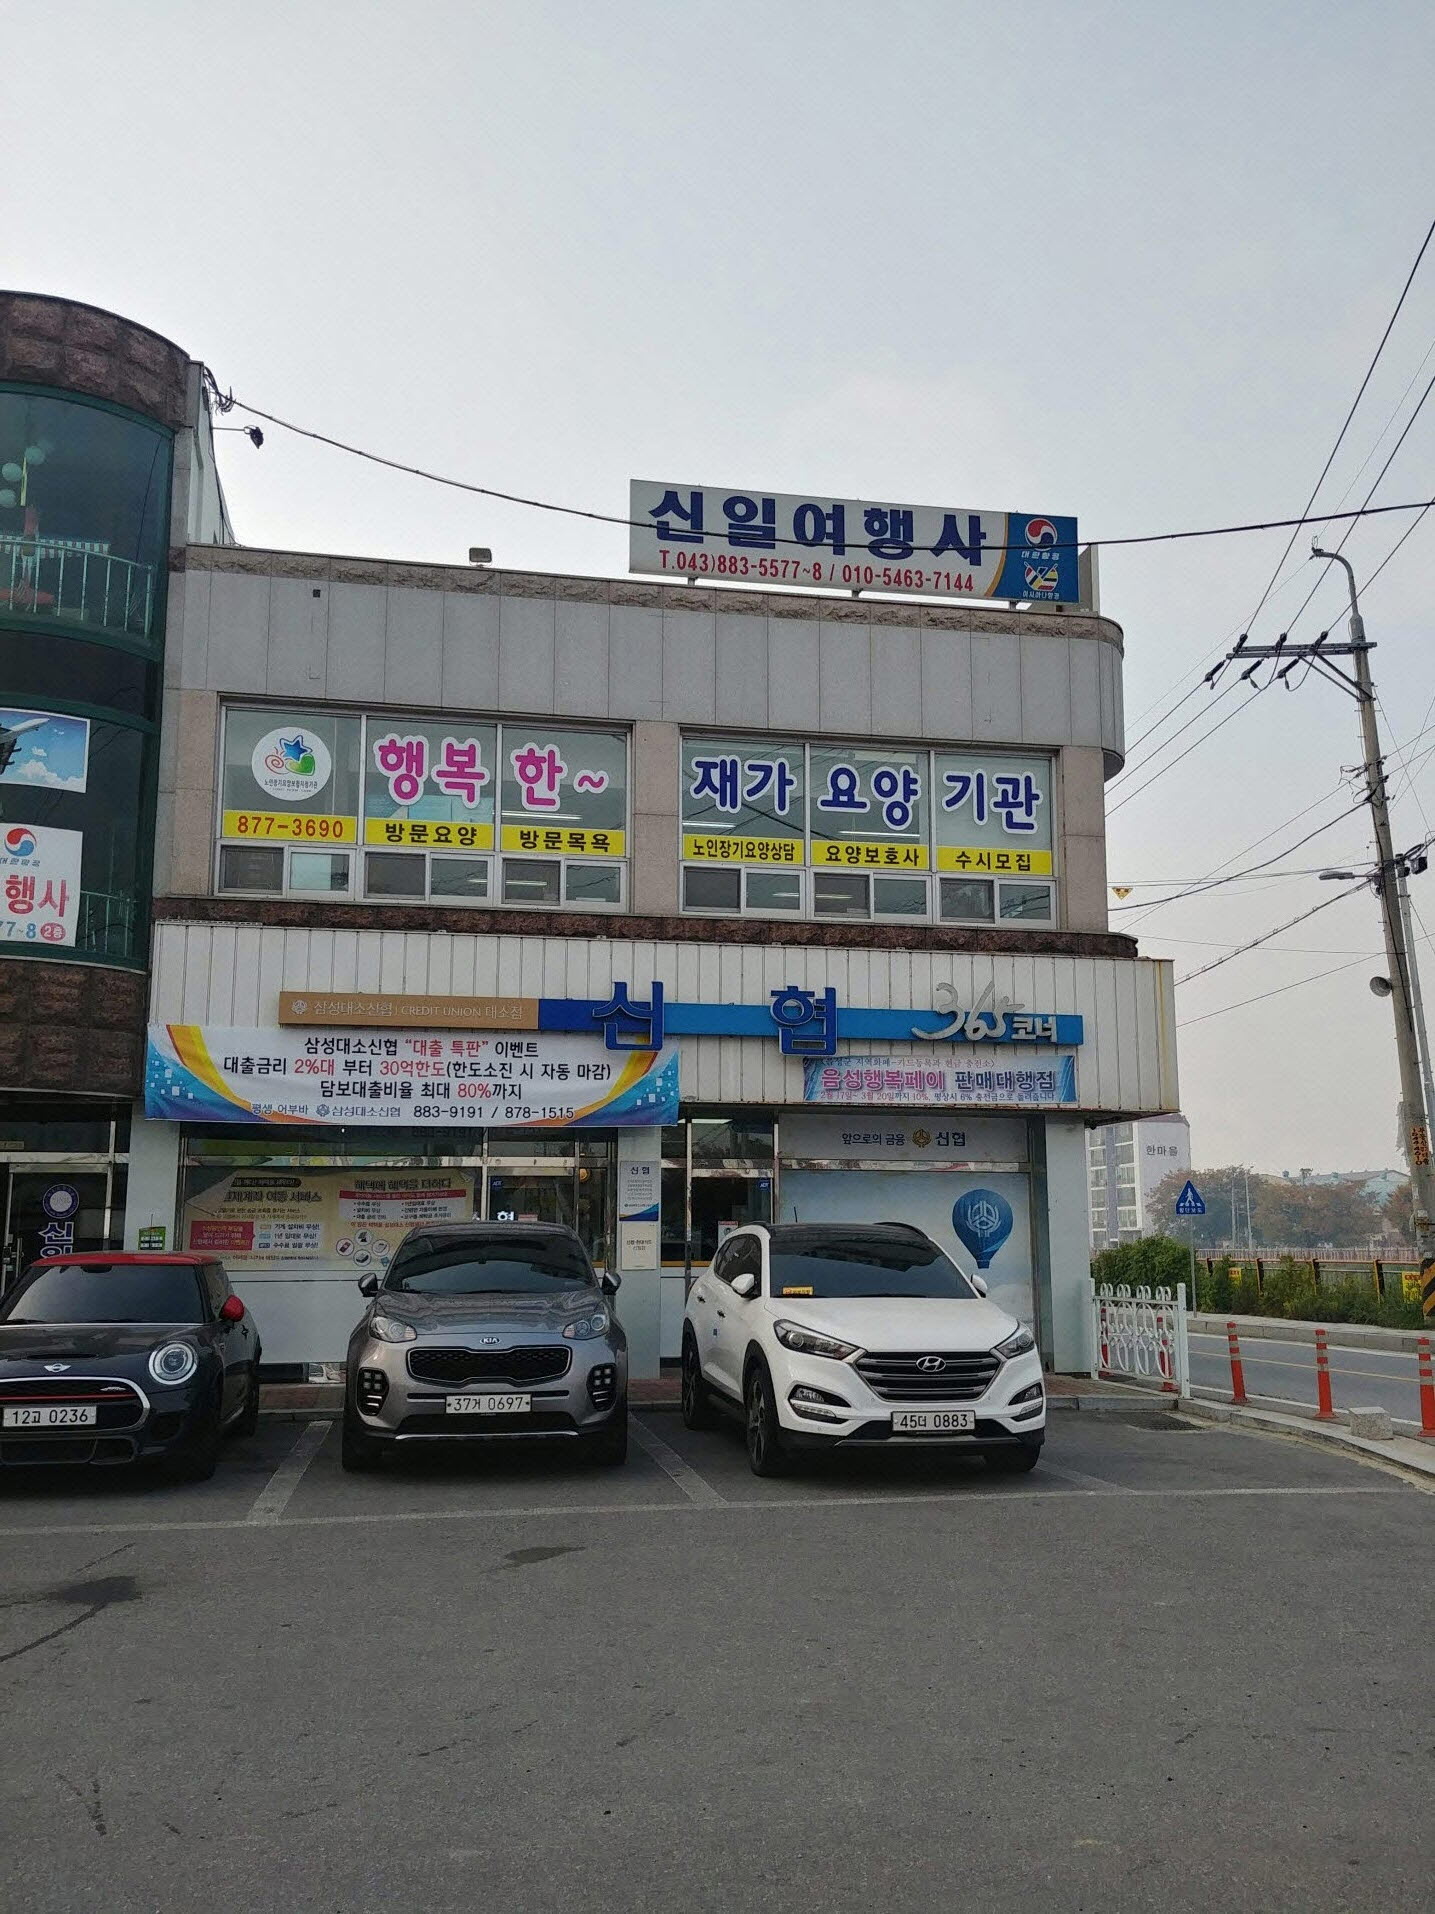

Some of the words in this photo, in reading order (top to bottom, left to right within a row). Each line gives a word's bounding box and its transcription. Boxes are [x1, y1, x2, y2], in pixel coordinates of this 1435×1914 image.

[648, 489, 986, 566] 신일여행사
[659, 550, 822, 581] T.043)883-5577~8
[842, 563, 974, 592] 010-5463-7144
[692, 757, 796, 813] 재가
[818, 765, 921, 829] 요양
[943, 769, 1042, 833] 기관
[237, 815, 344, 838] 877-3690
[385, 823, 478, 846] 방문요양
[519, 829, 611, 852] 방문목욕
[692, 840, 796, 861] 노인장기요양상담
[825, 844, 920, 866] 요양보호사
[955, 850, 1031, 872] 수시모집
[314, 1002, 393, 1017] 삼성대소신협
[401, 1006, 439, 1017] CREDIT
[442, 1006, 482, 1018] UNION
[304, 1037, 398, 1055] 삼성대소신협
[495, 1041, 539, 1058] 이벤트
[223, 1056, 287, 1075] 대출금리
[293, 1059, 335, 1076] 2%대
[342, 1060, 372, 1077] 부터
[519, 1062, 534, 1079] 시
[541, 1063, 571, 1081] 자동
[577, 1063, 612, 1080] 마감)
[320, 1080, 414, 1099] 담보대출비율
[421, 1082, 451, 1099] 최대
[457, 1083, 522, 1100] 80%까지
[821, 1067, 945, 1090] 음성행복페이
[954, 1070, 1055, 1092] 판매대행점
[277, 1104, 309, 1116] 어부바
[413, 1105, 483, 1119] 883-9191
[504, 1106, 574, 1120] 878-1515
[841, 1132, 882, 1146] 앞으로의
[885, 1133, 905, 1146] 금융
[935, 1131, 967, 1147] 신협
[1146, 1145, 1178, 1156] 한마을
[453, 1397, 481, 1411] 37거
[487, 1396, 524, 1411] 0697
[48, 1408, 89, 1423] 0236
[900, 1413, 927, 1428] 45더
[933, 1413, 968, 1428] 0883
